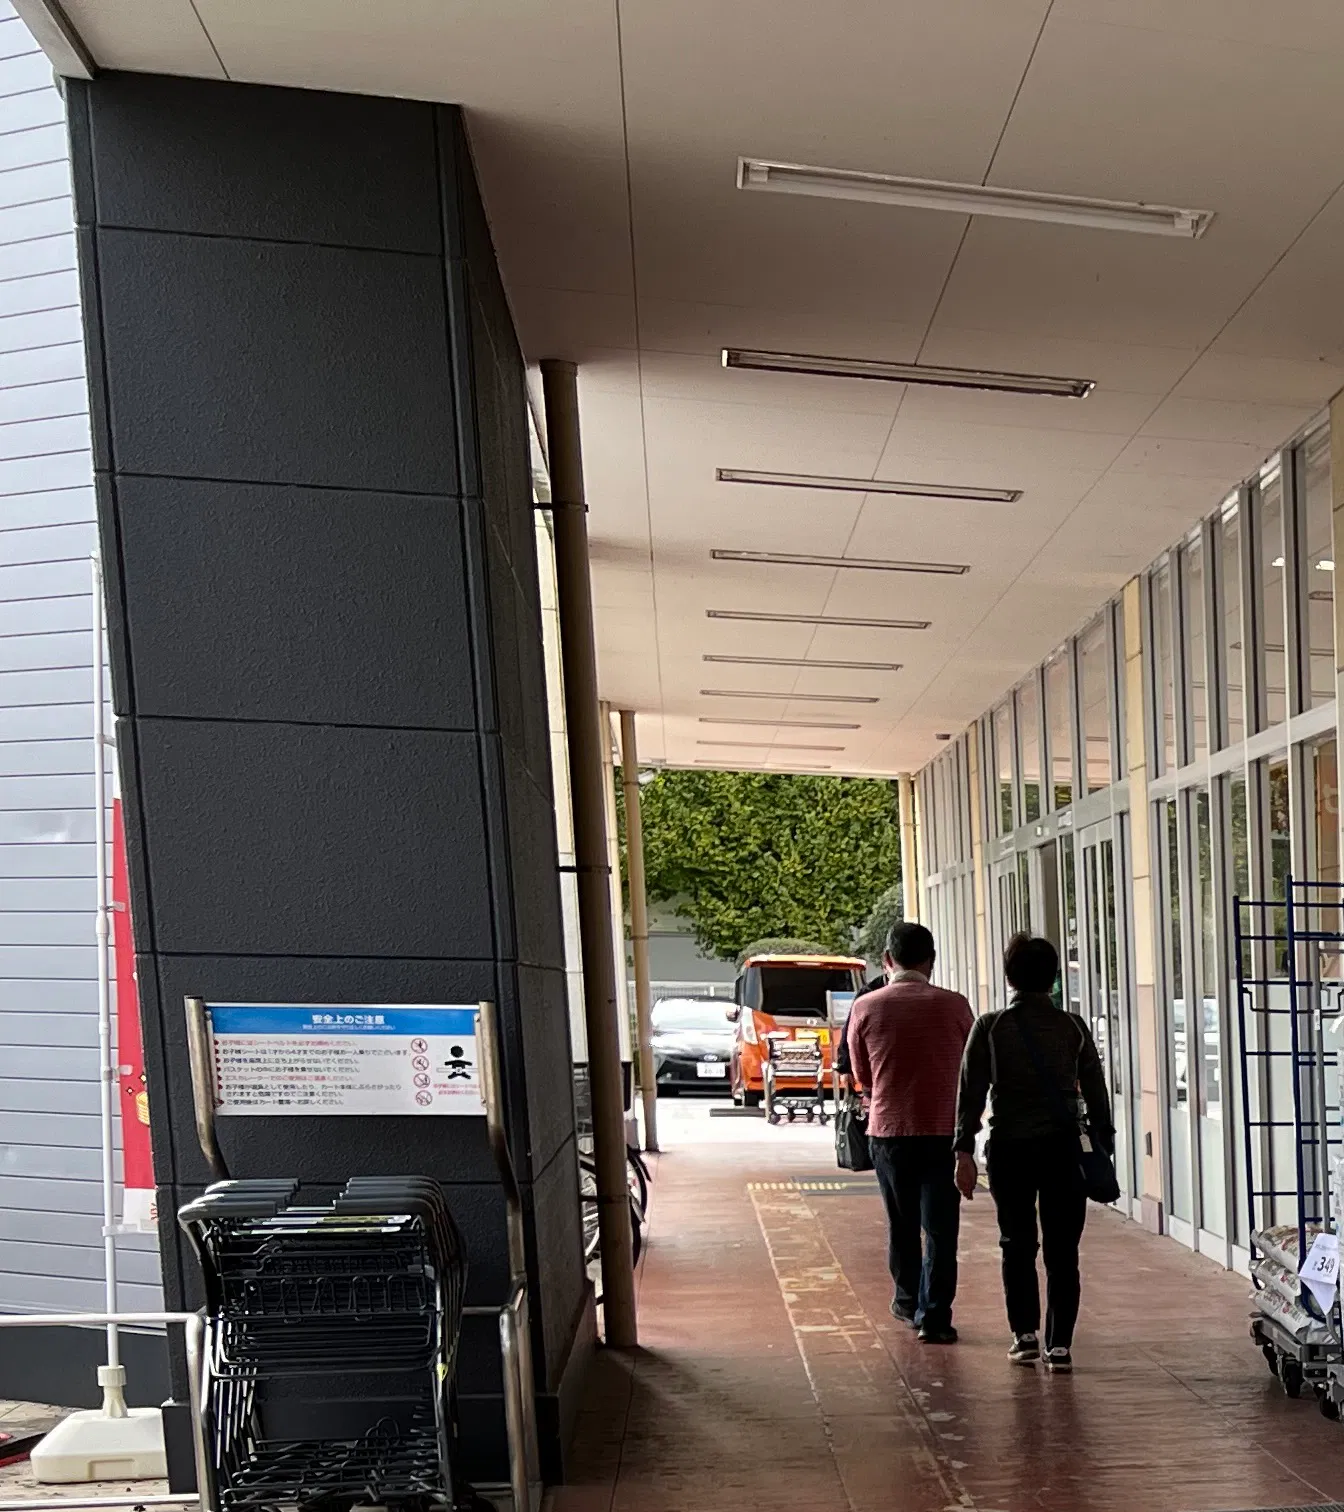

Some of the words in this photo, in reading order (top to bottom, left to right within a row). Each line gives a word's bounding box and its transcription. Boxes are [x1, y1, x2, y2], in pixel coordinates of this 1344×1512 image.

[312, 1014, 385, 1025] 安全上のご注意
